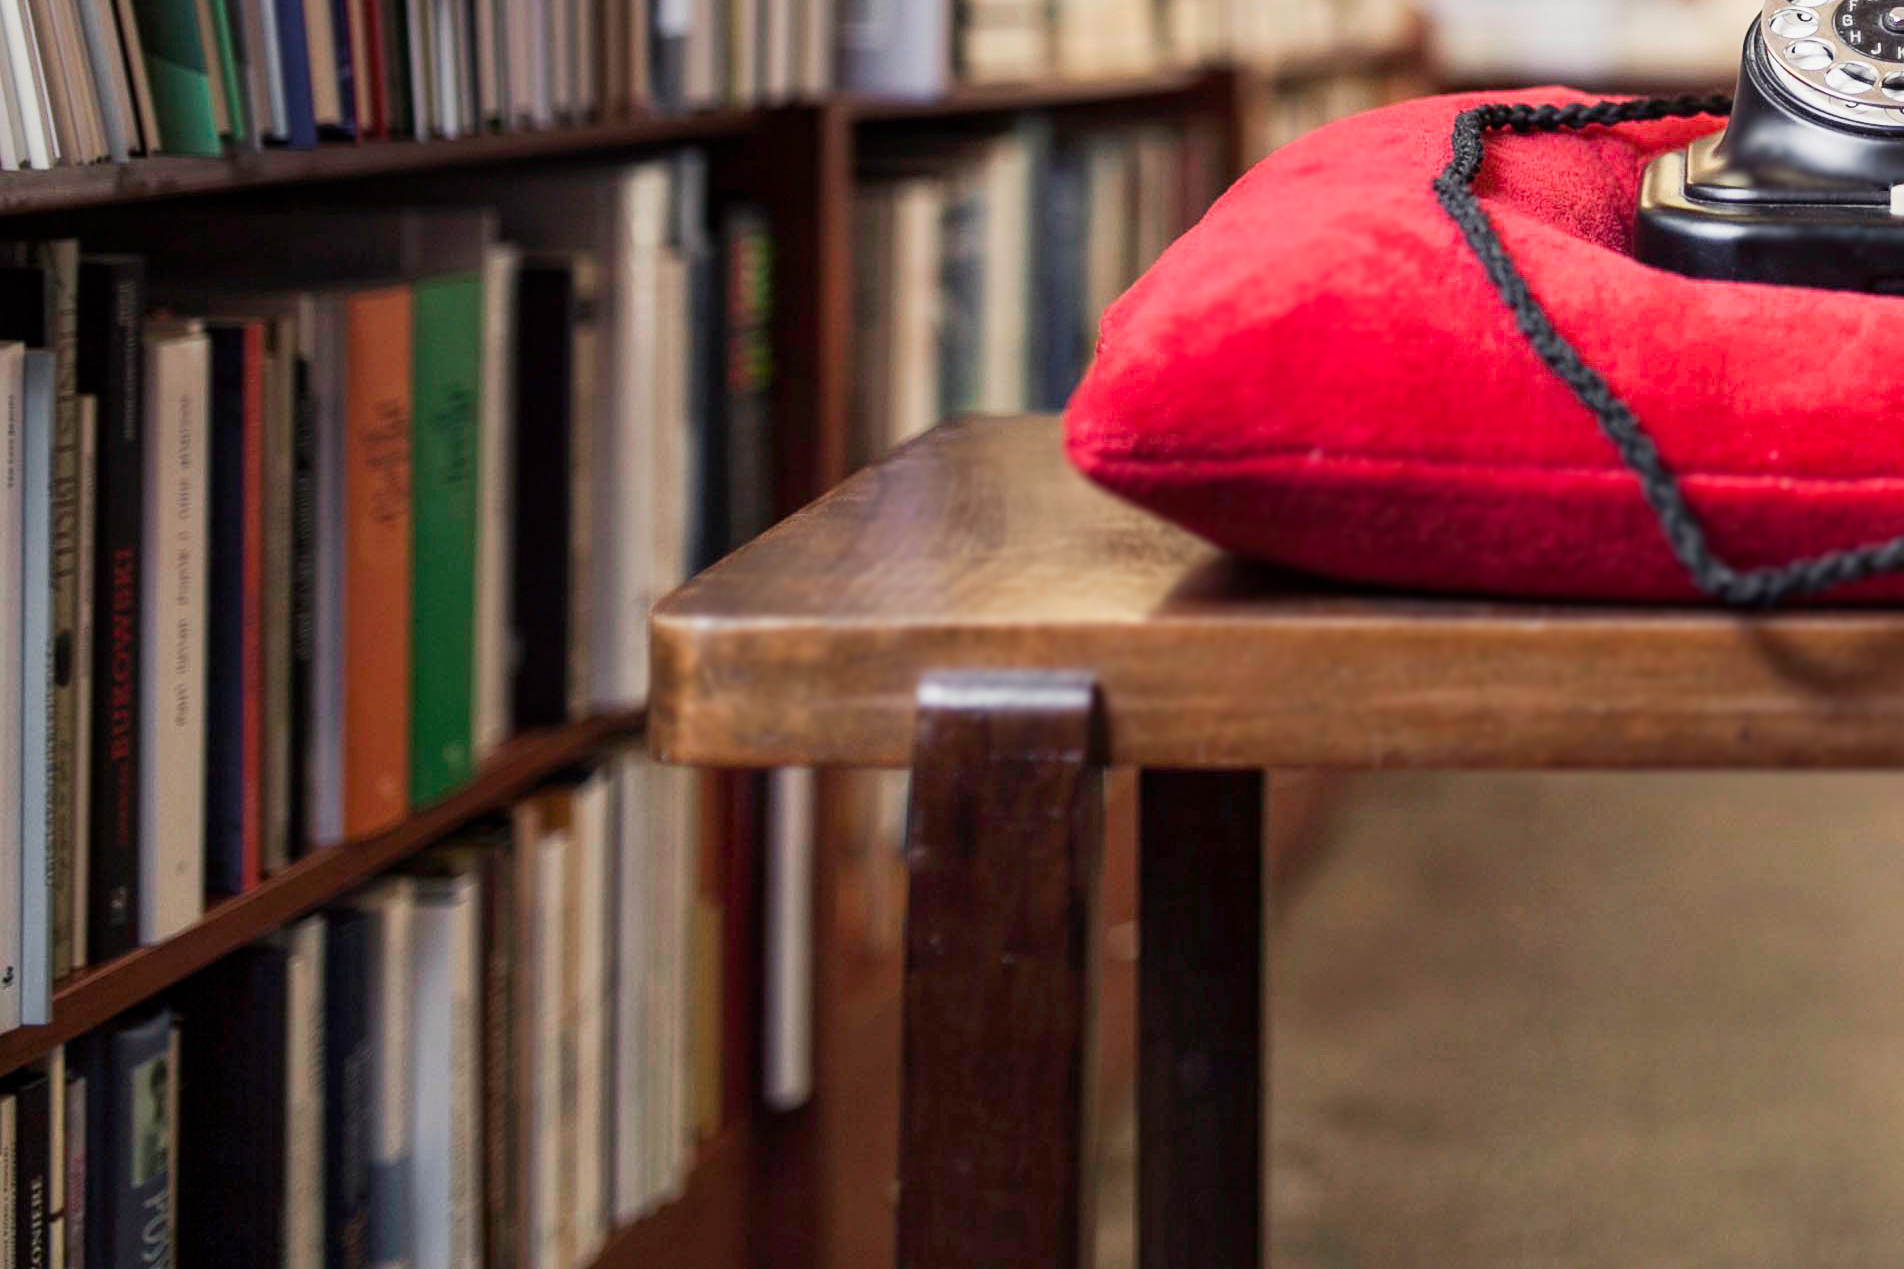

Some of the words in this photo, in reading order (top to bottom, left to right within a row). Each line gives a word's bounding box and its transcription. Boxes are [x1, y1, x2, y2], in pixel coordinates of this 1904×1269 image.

[1842, 14, 1853, 27] G
[1850, 31, 1861, 43] H
[1871, 42, 1882, 55] J
[111, 545, 134, 762] BUKOWSKI
